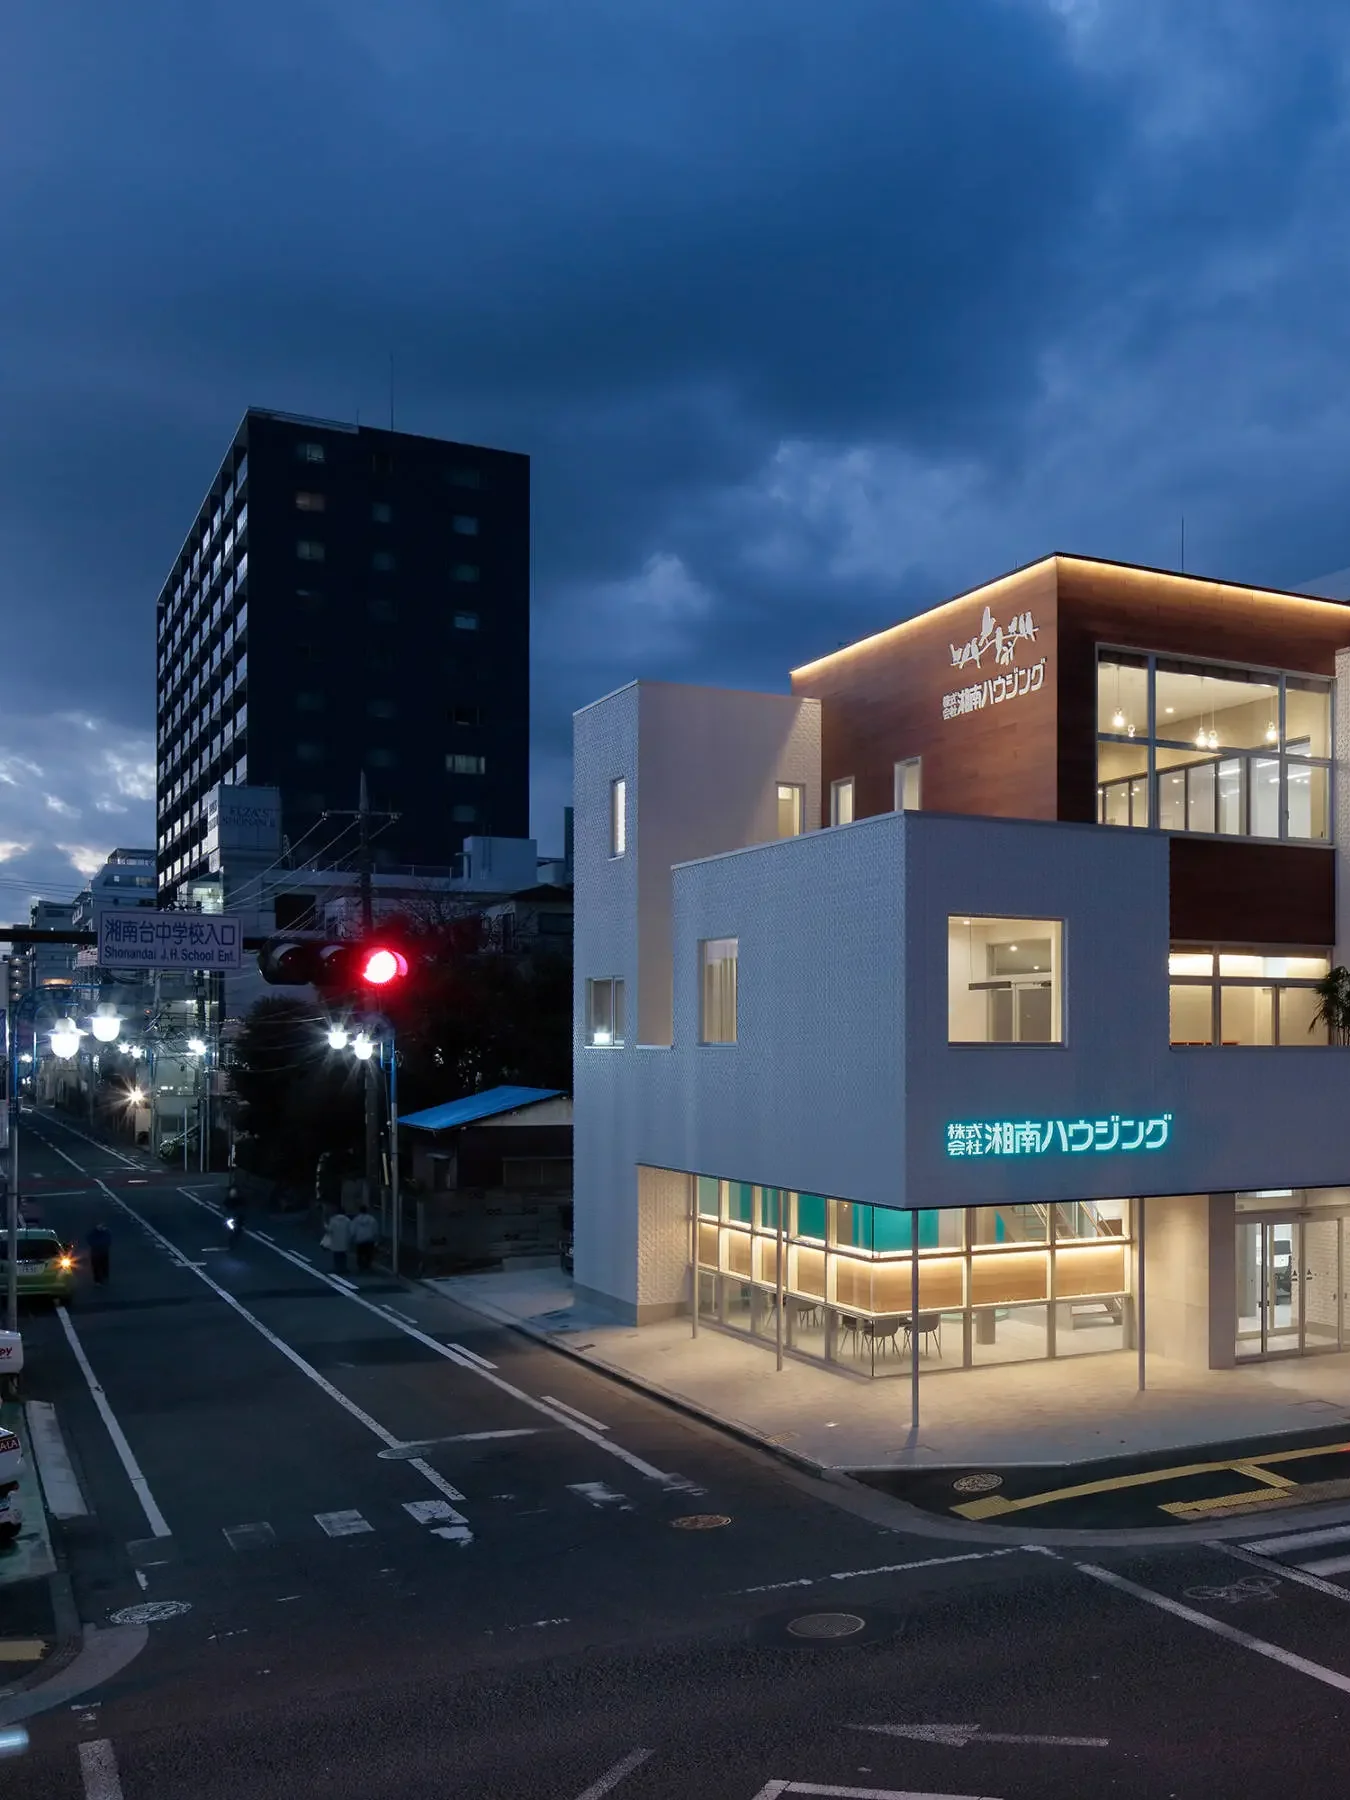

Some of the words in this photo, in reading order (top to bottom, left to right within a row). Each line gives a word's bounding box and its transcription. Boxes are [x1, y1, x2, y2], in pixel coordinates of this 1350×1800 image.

[104, 918, 235, 946] 湘南台中学校入口
[104, 945, 156, 960] Shonandai
[984, 1113, 1173, 1155] 湘南ハウジング
